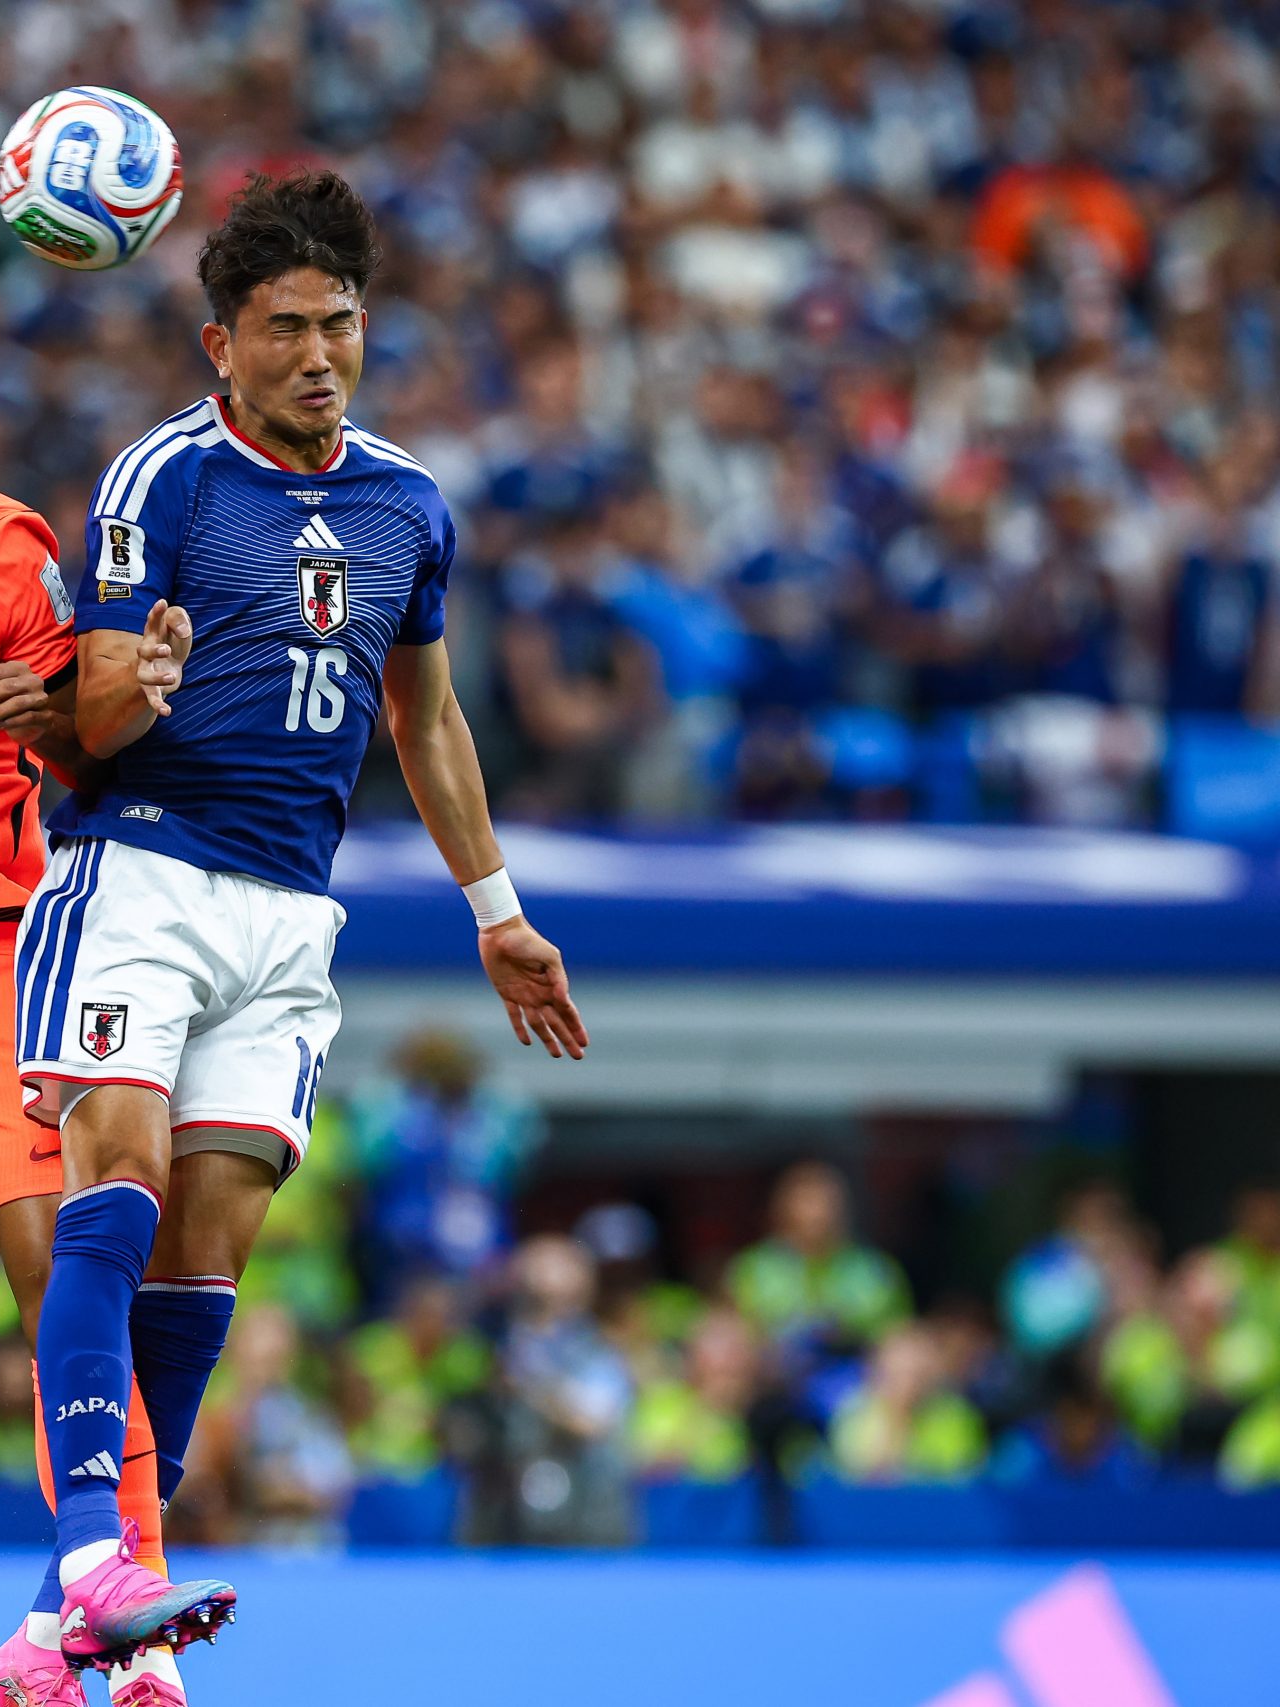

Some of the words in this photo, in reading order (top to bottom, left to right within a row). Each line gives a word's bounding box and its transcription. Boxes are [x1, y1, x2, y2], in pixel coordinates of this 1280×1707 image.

[310, 560, 336, 569] JAPAN
[108, 571, 131, 579] 2026
[312, 611, 334, 625] JFA
[285, 646, 348, 734] 16
[92, 1003, 118, 1011] JAPAN
[91, 1042, 112, 1051] JFA
